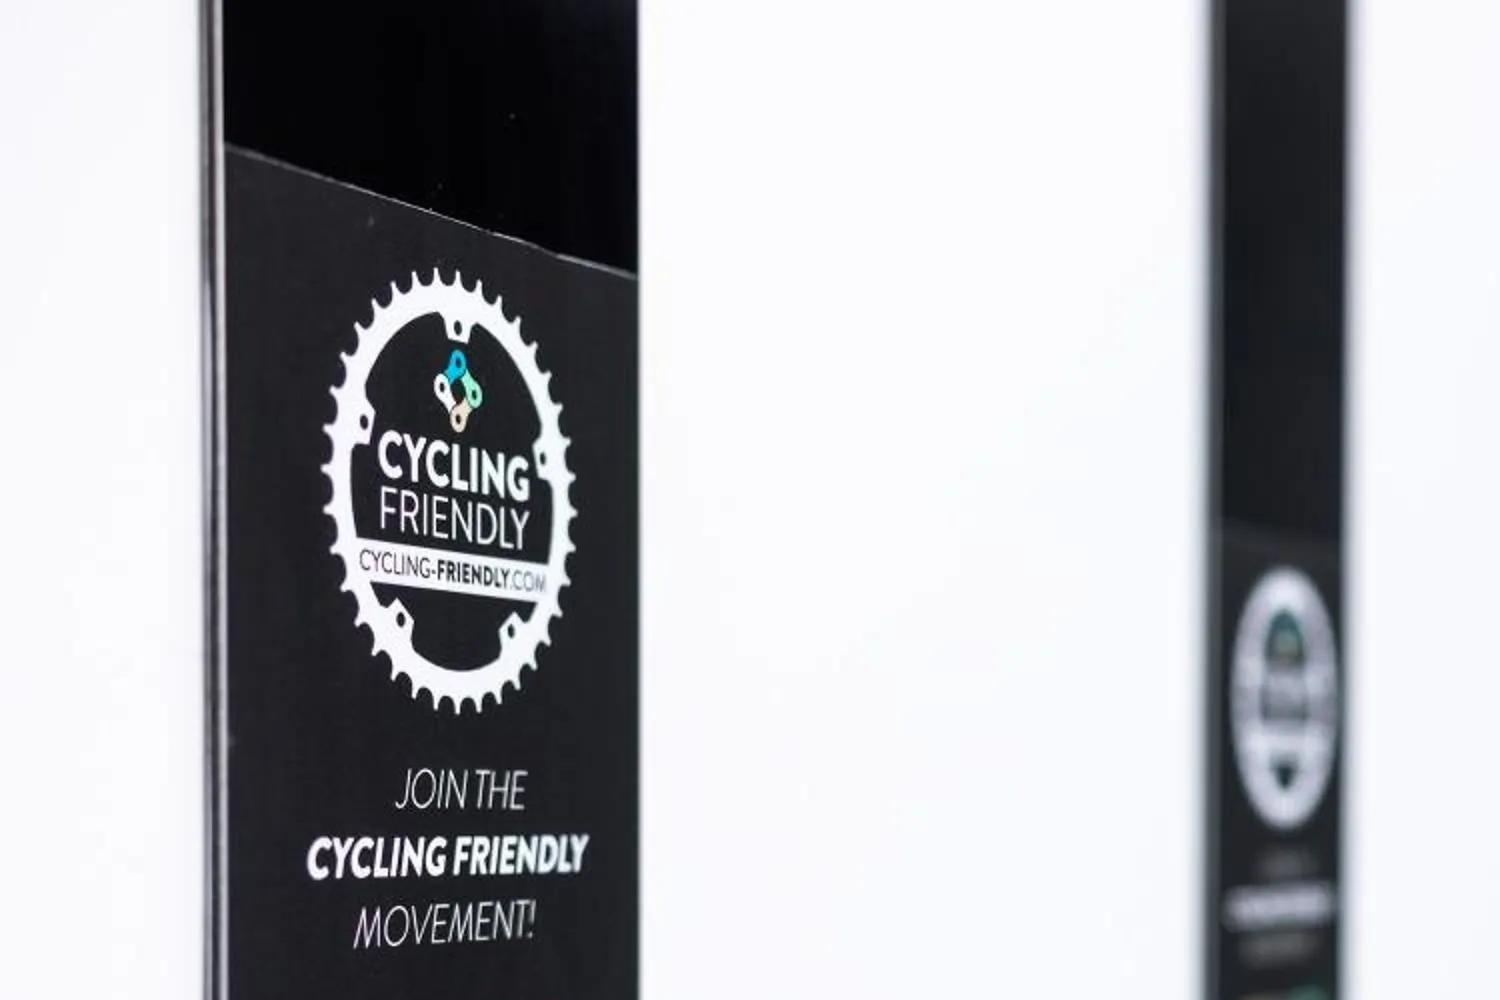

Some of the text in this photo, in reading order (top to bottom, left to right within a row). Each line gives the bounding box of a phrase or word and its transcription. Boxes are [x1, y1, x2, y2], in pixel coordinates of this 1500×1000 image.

[377, 429, 530, 503] CYCLING
[380, 484, 531, 551] FRIENDLY
[358, 547, 548, 594] CYCLING-FRIENDLY.COM
[395, 767, 529, 810] JOIN THE
[306, 833, 590, 881] CYCLING FRIENDLY
[353, 899, 537, 950] MOVEMENT!
